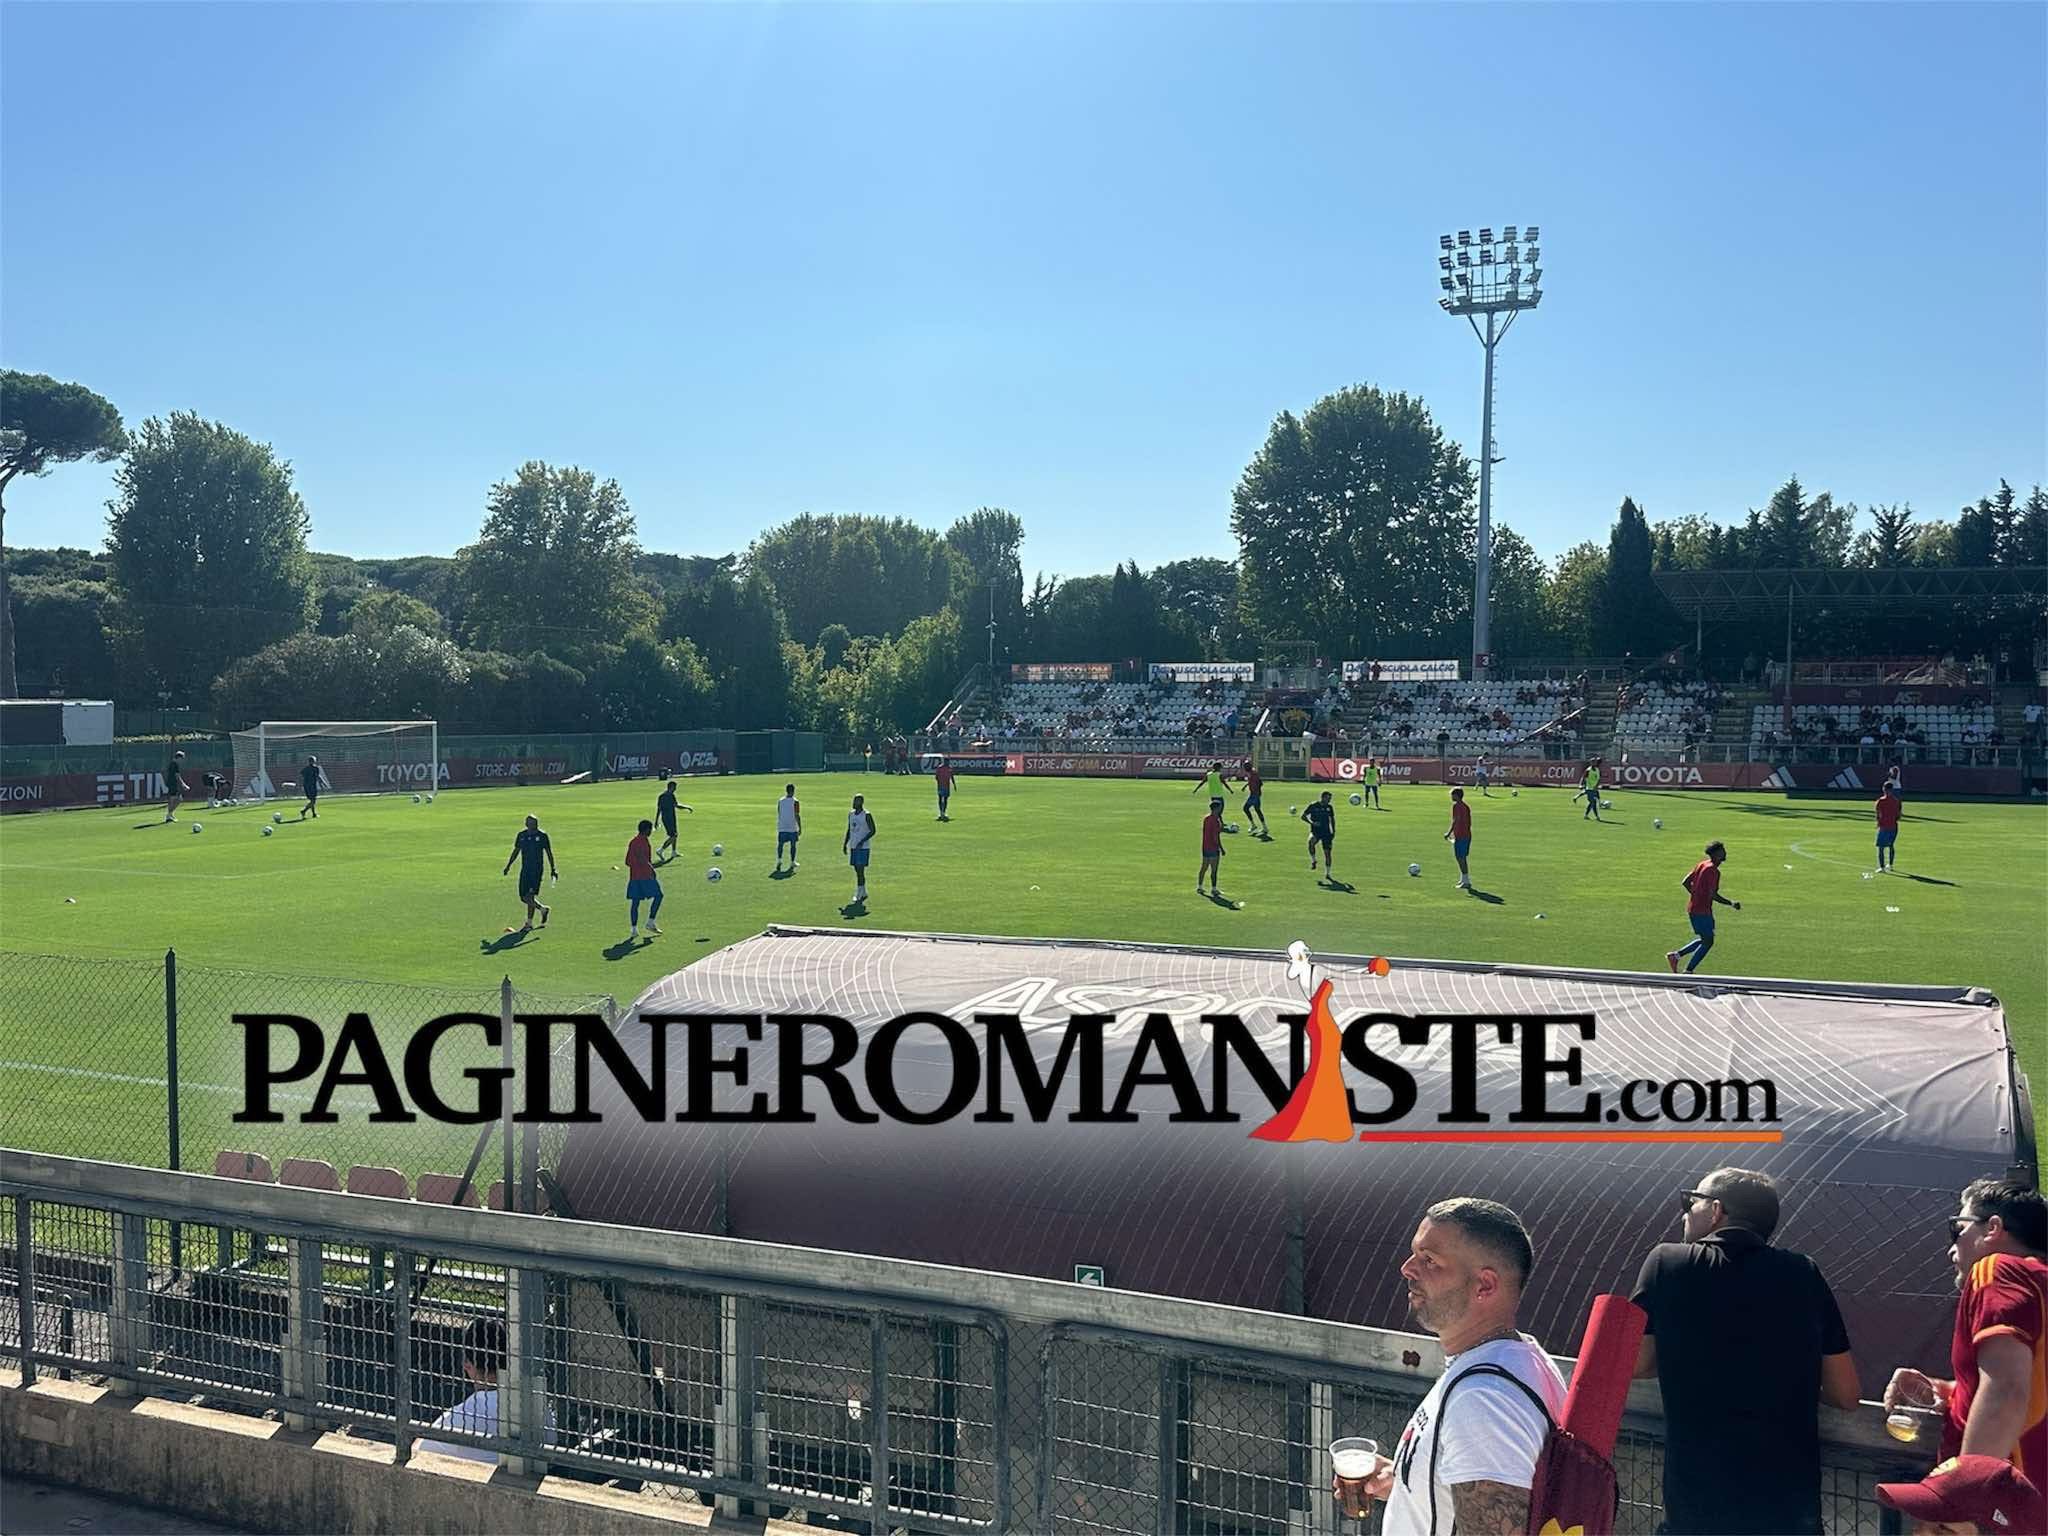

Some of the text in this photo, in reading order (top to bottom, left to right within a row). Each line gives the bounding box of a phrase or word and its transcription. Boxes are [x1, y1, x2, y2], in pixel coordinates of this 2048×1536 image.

[1482, 656, 1489, 666] 3
[2000, 652, 2009, 663] 5
[1316, 658, 1323, 668] 2
[1382, 663, 1456, 672] SCUOLA CALCIO
[1219, 665, 1252, 674] CALCIO
[1448, 764, 1575, 778] STO.ASROMA.COM
[1611, 766, 1703, 784] TOYOTA
